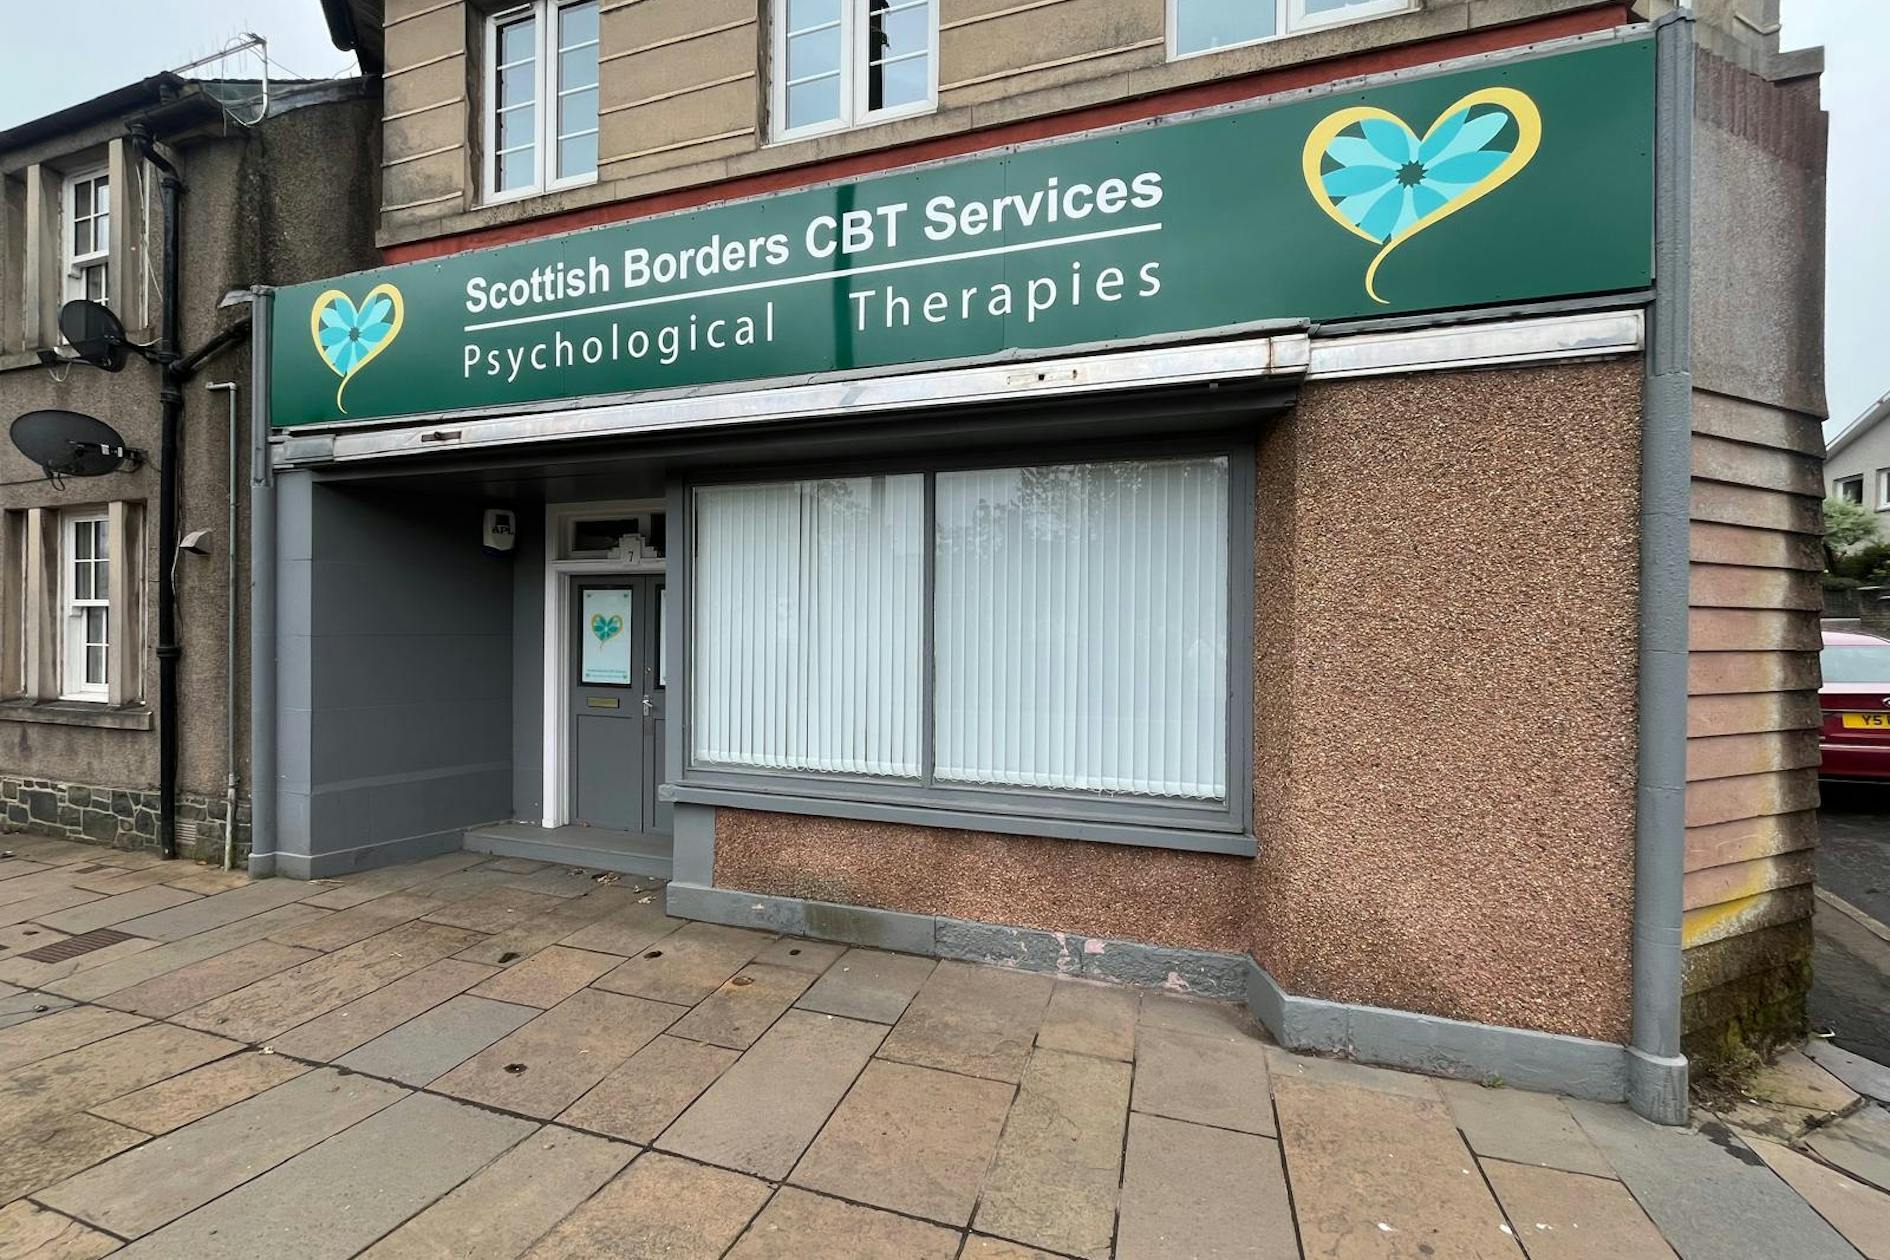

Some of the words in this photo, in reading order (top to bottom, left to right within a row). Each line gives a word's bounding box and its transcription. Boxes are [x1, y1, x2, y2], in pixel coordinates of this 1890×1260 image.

[465, 256, 610, 313] Scottish
[624, 233, 789, 289] Borders
[805, 202, 908, 259] CBT
[924, 171, 1164, 241] Services
[464, 301, 774, 383] Psychological
[848, 261, 1161, 331] Therapies
